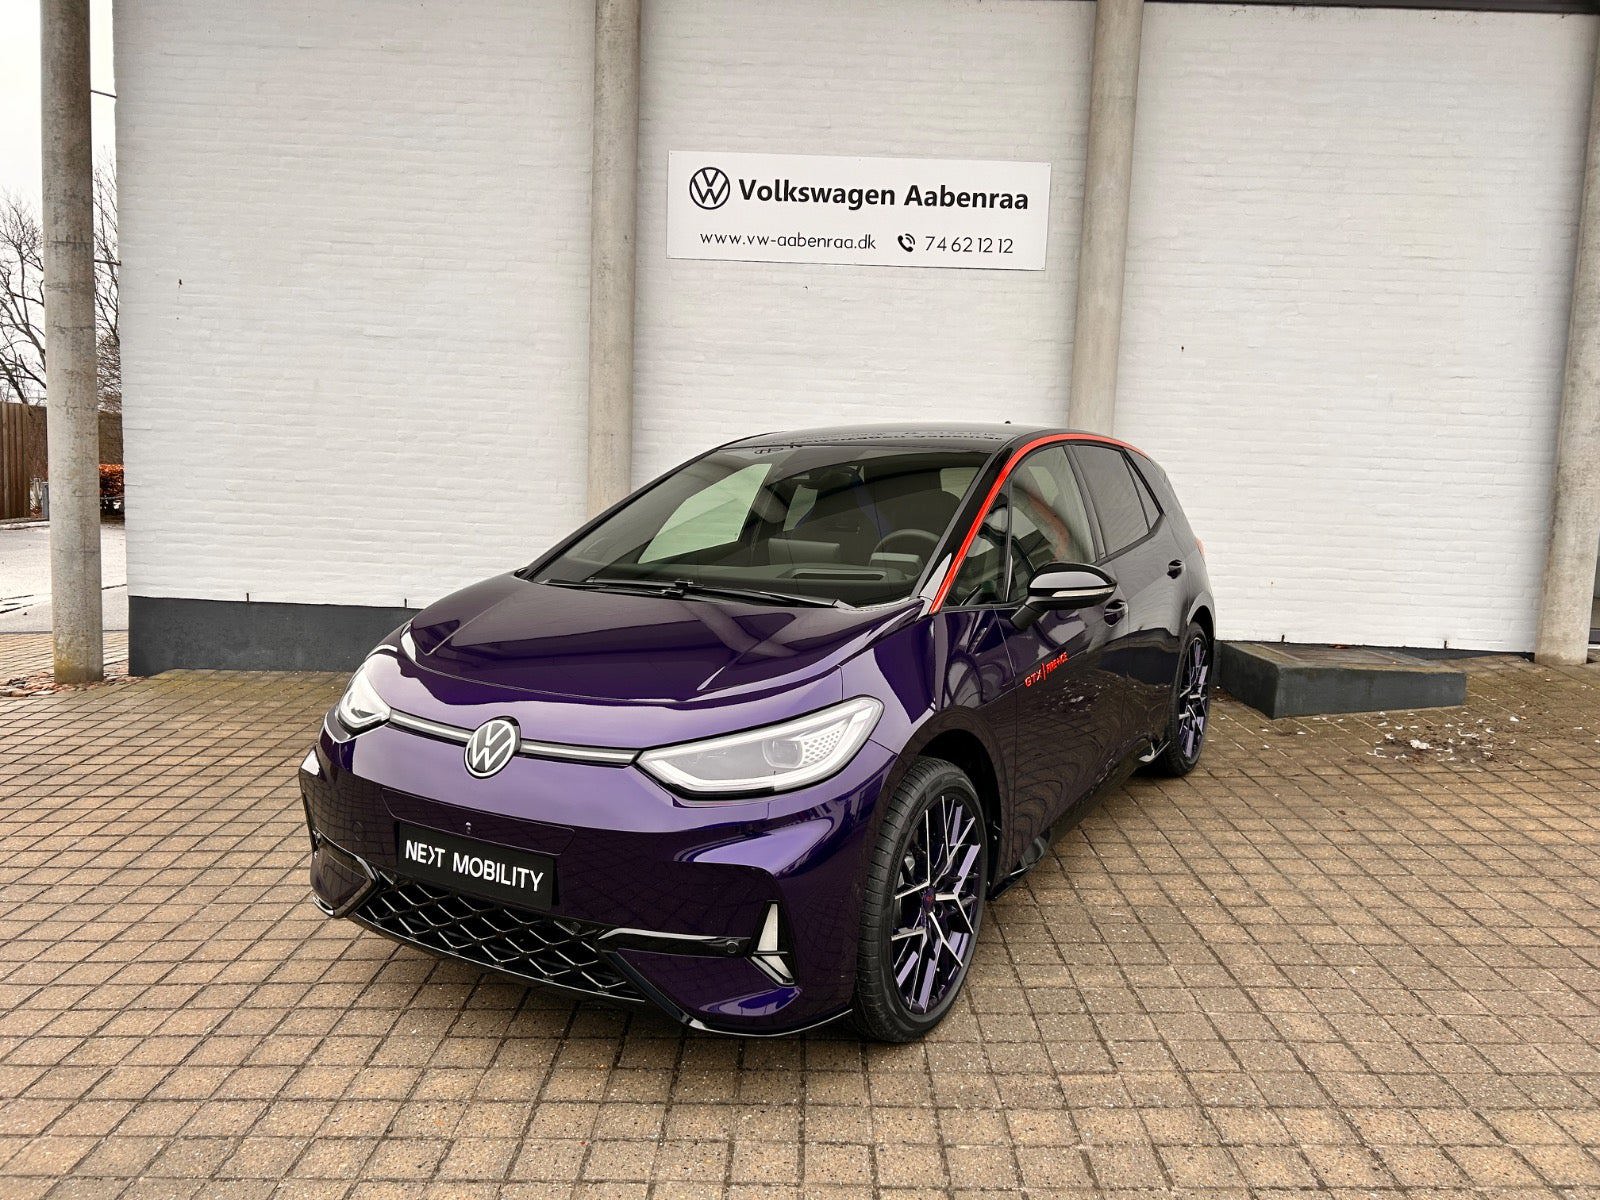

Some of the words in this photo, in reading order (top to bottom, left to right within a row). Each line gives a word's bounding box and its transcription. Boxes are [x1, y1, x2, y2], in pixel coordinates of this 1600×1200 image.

[738, 178, 895, 210] Volkswagen
[904, 184, 1028, 210] Aabenraa
[700, 232, 876, 249] www.vw-aabenraa.dk
[1024, 669, 1042, 688] GTX
[452, 852, 544, 892] MOBILITY
